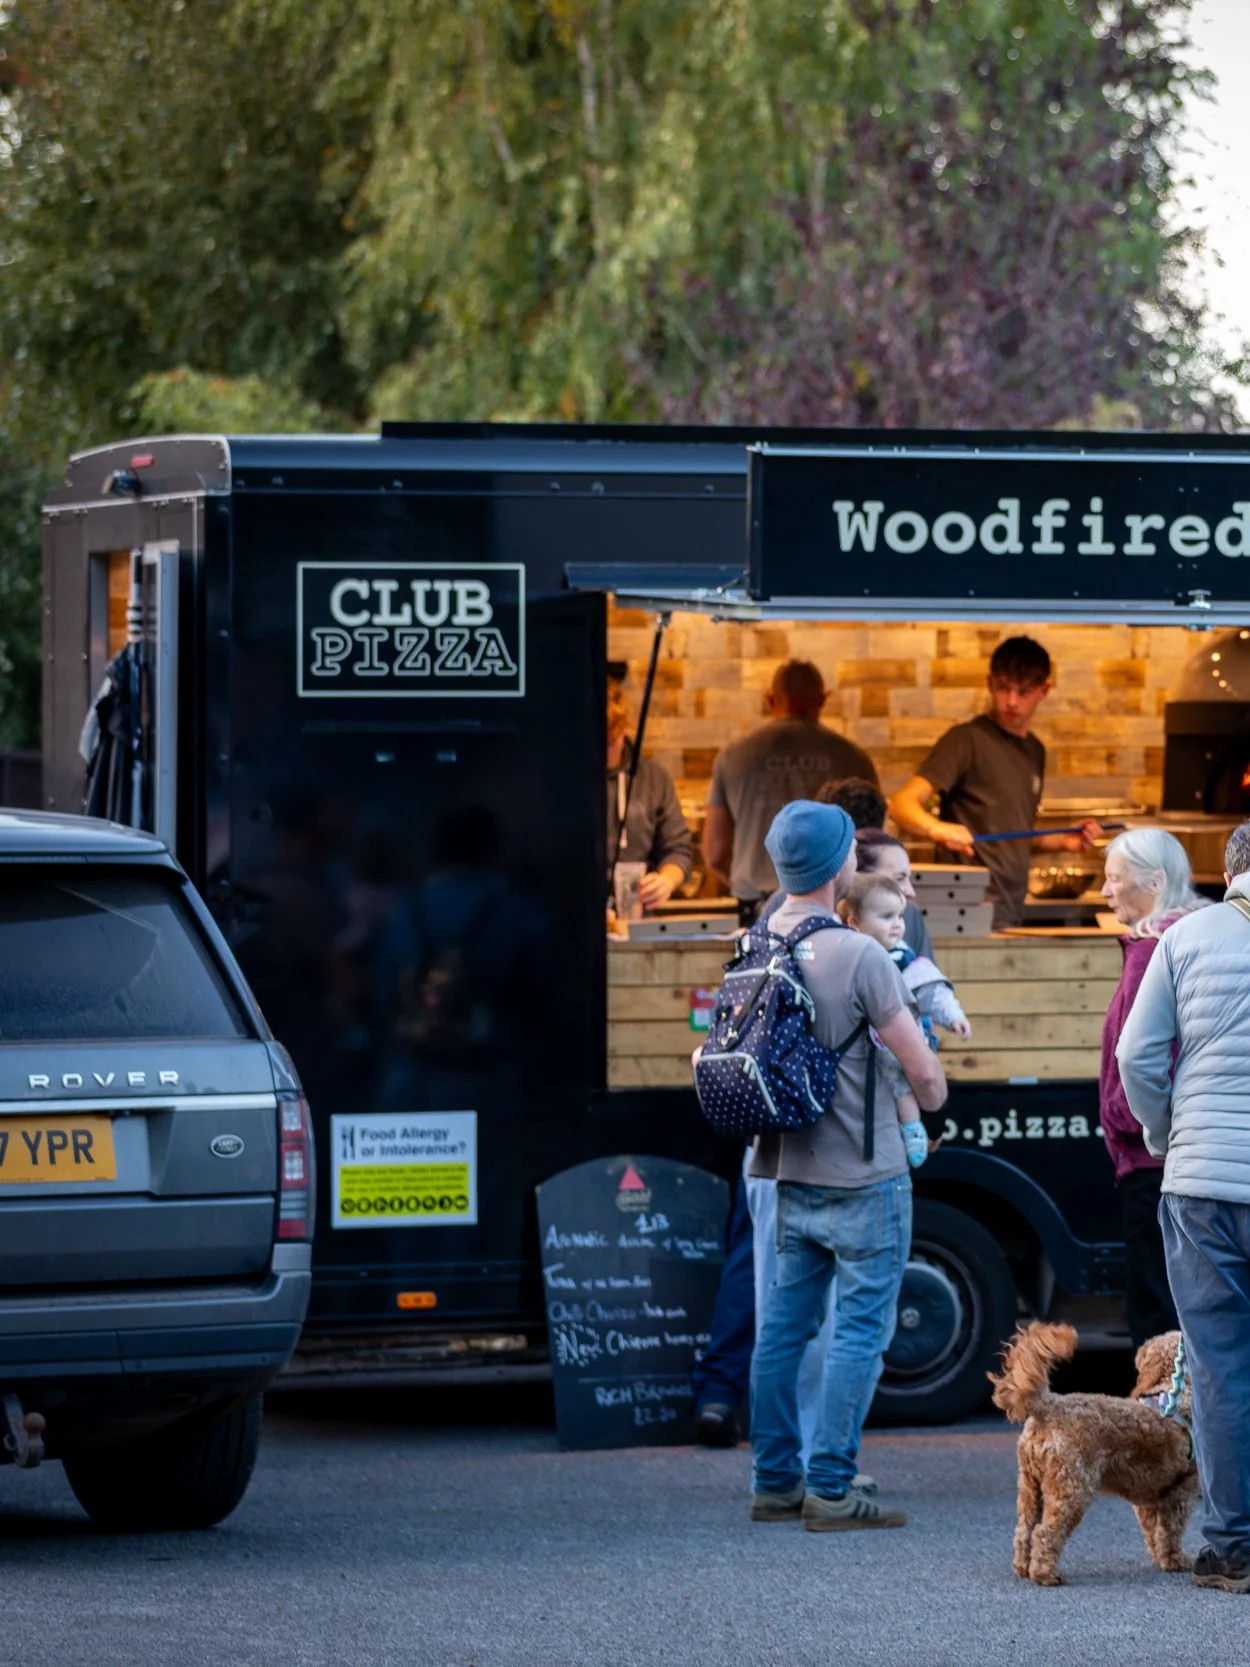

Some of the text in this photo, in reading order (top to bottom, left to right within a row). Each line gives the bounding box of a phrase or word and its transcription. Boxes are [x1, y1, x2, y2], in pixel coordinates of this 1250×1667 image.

[330, 578, 493, 627] CLUB
[310, 627, 517, 676] PIZZA
[28, 1071, 179, 1089] ROVER
[21, 1129, 95, 1166] YPR
[360, 1127, 449, 1142] Food Allergy
[361, 1141, 467, 1157] or Intolerance?
